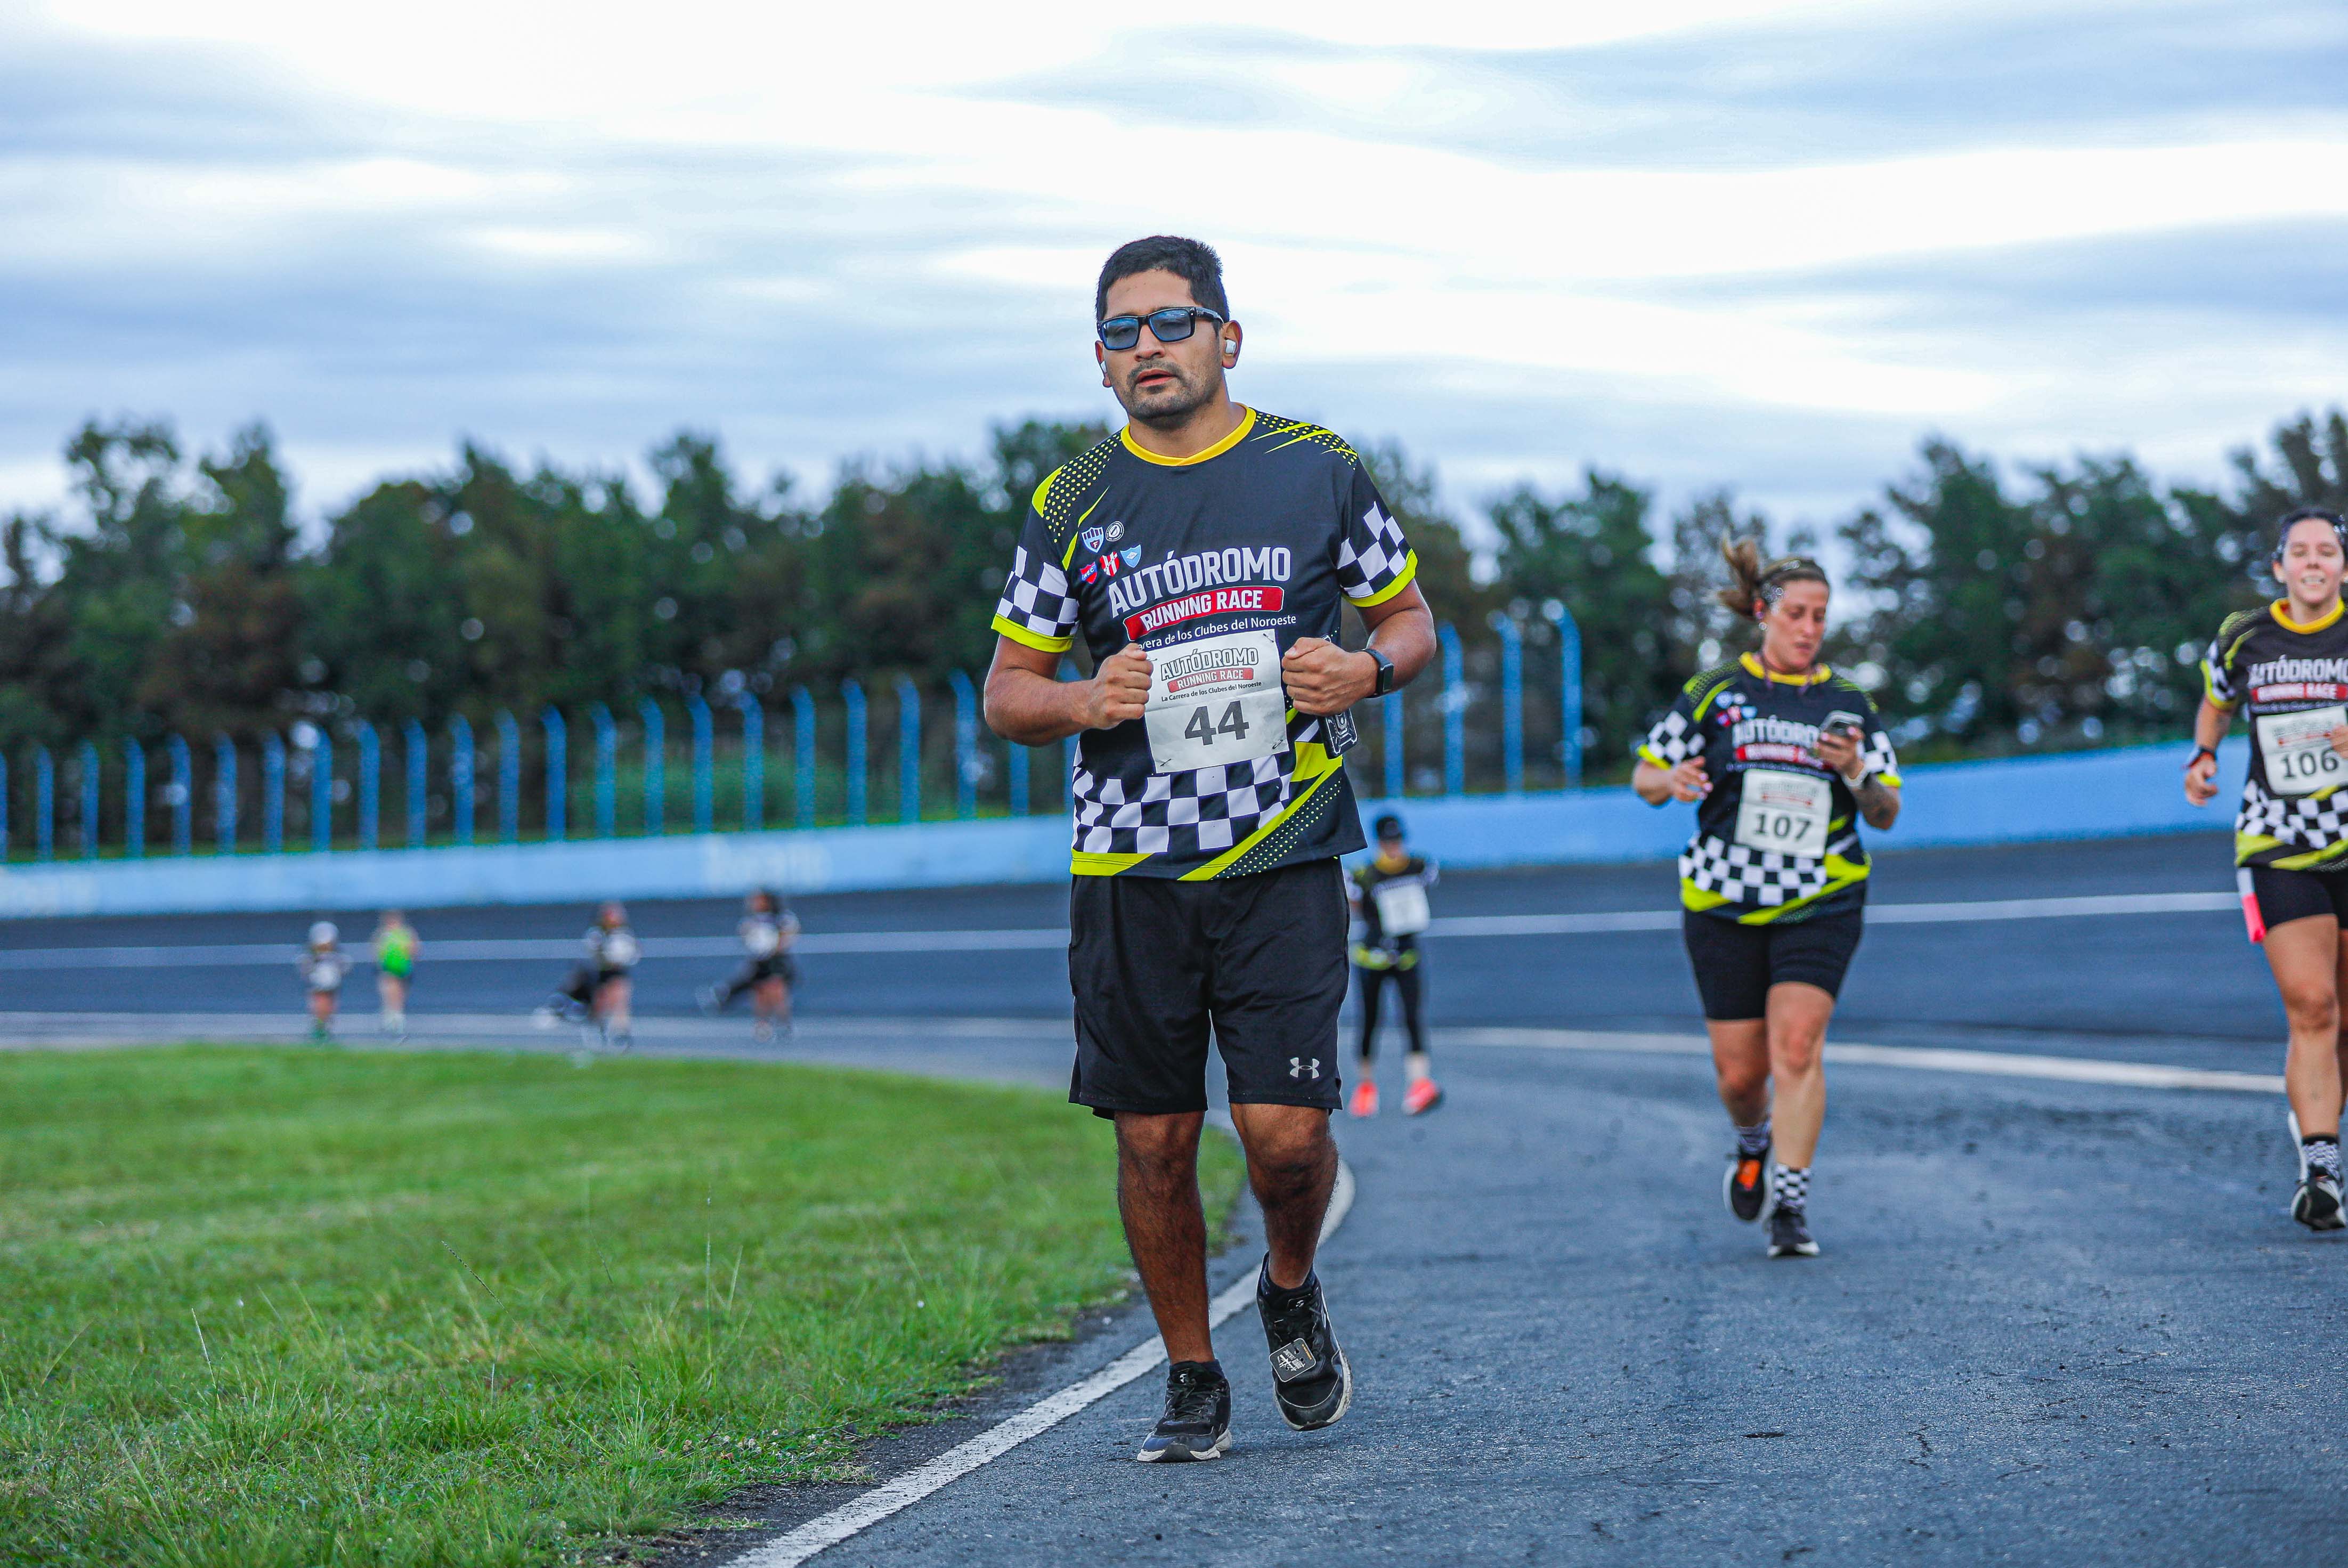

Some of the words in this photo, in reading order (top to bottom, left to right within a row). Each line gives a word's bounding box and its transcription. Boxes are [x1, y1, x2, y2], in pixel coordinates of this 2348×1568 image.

[1109, 547, 1291, 618] AUTÓDROMO
[1140, 594, 1212, 632] RUNNING
[1216, 590, 1263, 610] RACE
[1165, 633, 1175, 645] de
[1177, 630, 1192, 640] los
[1195, 622, 1229, 637] Clubes
[1231, 619, 1248, 630] del
[1251, 614, 1296, 627] Noroeste
[1160, 648, 1259, 681] AUTÓDROMO
[1177, 671, 1217, 689] RUNNING
[1220, 669, 1244, 680] RACE
[1169, 692, 1190, 701] Carrera
[1184, 700, 1249, 746] 44
[1733, 714, 1821, 749] AUTÓDRO
[2280, 747, 2339, 779] 106
[1753, 814, 1813, 841] 107
